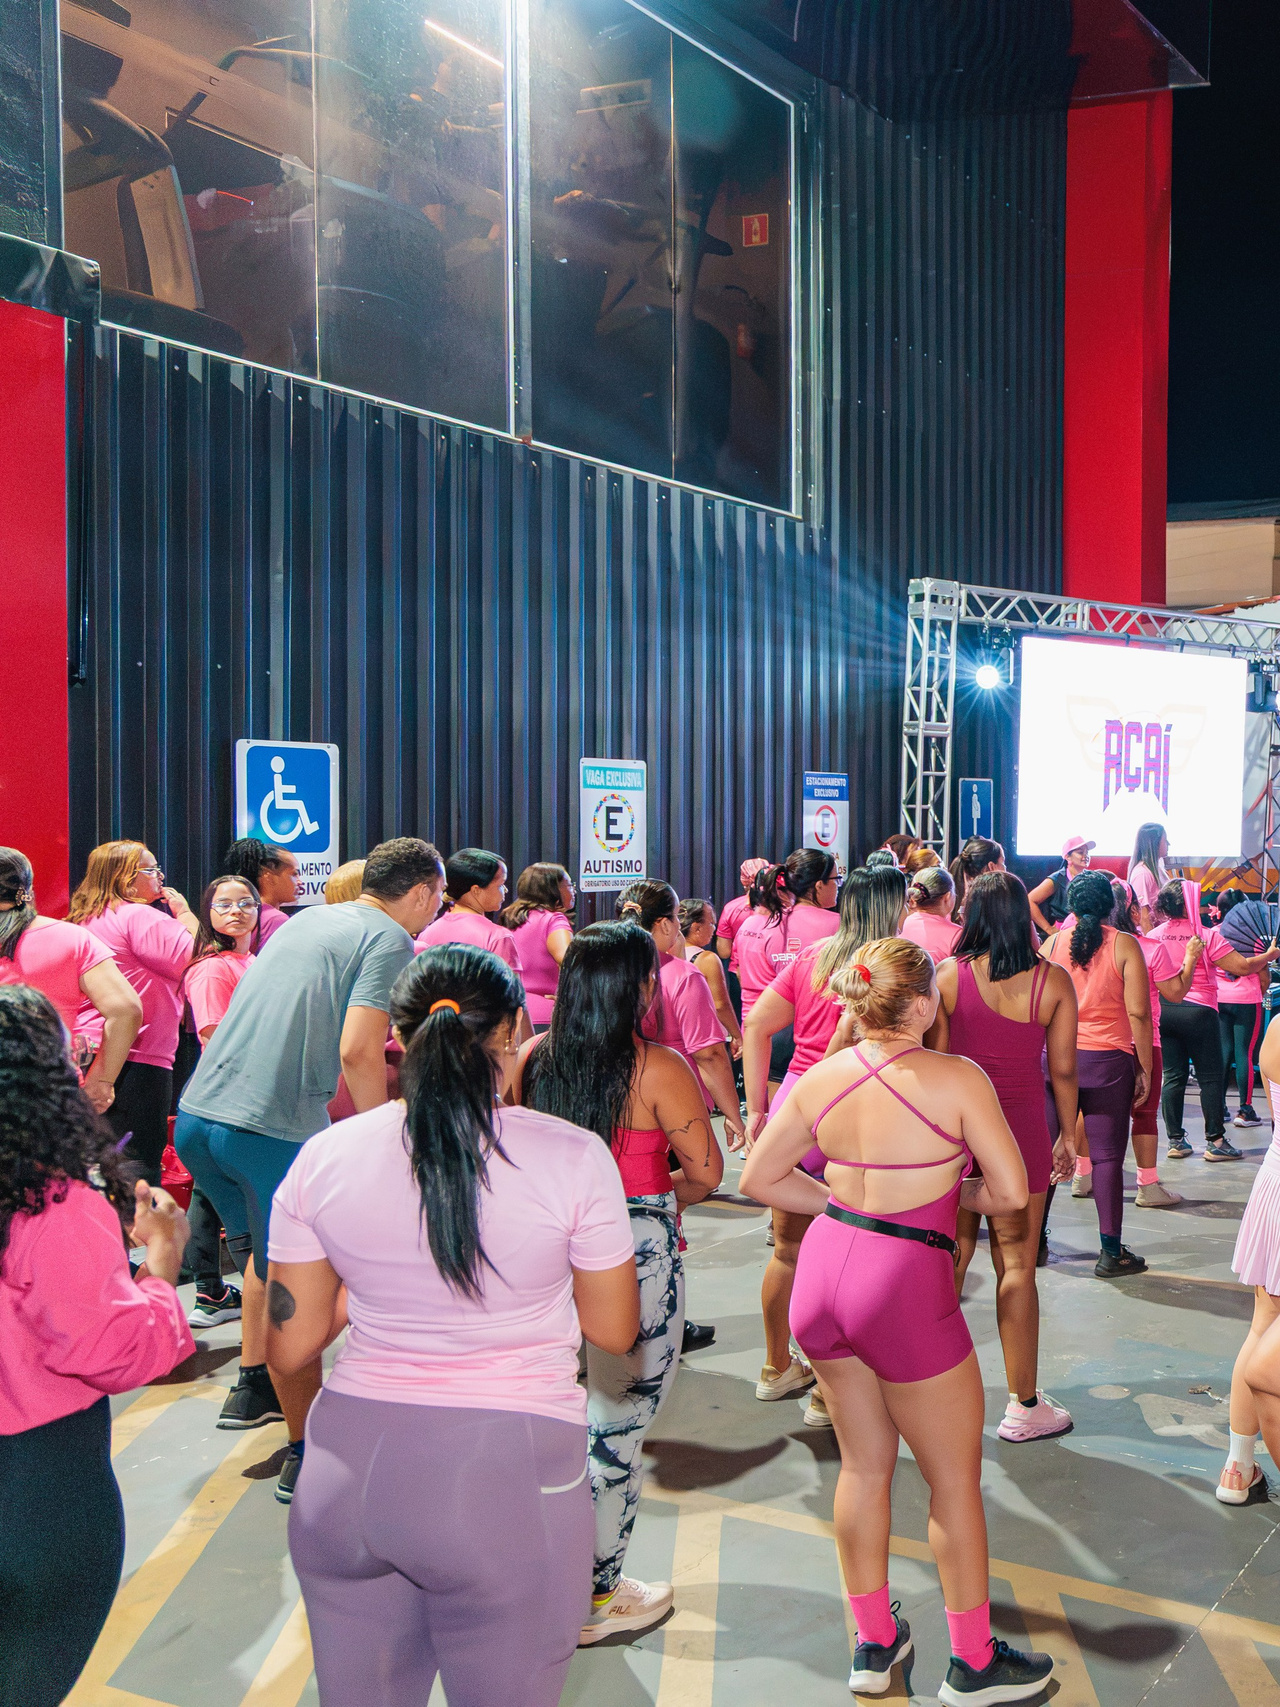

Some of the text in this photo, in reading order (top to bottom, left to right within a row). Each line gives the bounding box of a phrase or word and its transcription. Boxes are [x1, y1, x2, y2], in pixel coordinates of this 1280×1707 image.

[585, 769, 642, 788] VAGA EXCLUSIVA
[806, 776, 847, 787] ESTACIONAMENTO
[814, 788, 839, 798] EXCLUSIVO
[606, 806, 624, 841] E
[821, 813, 831, 838] E
[583, 860, 643, 874] AUTISMO
